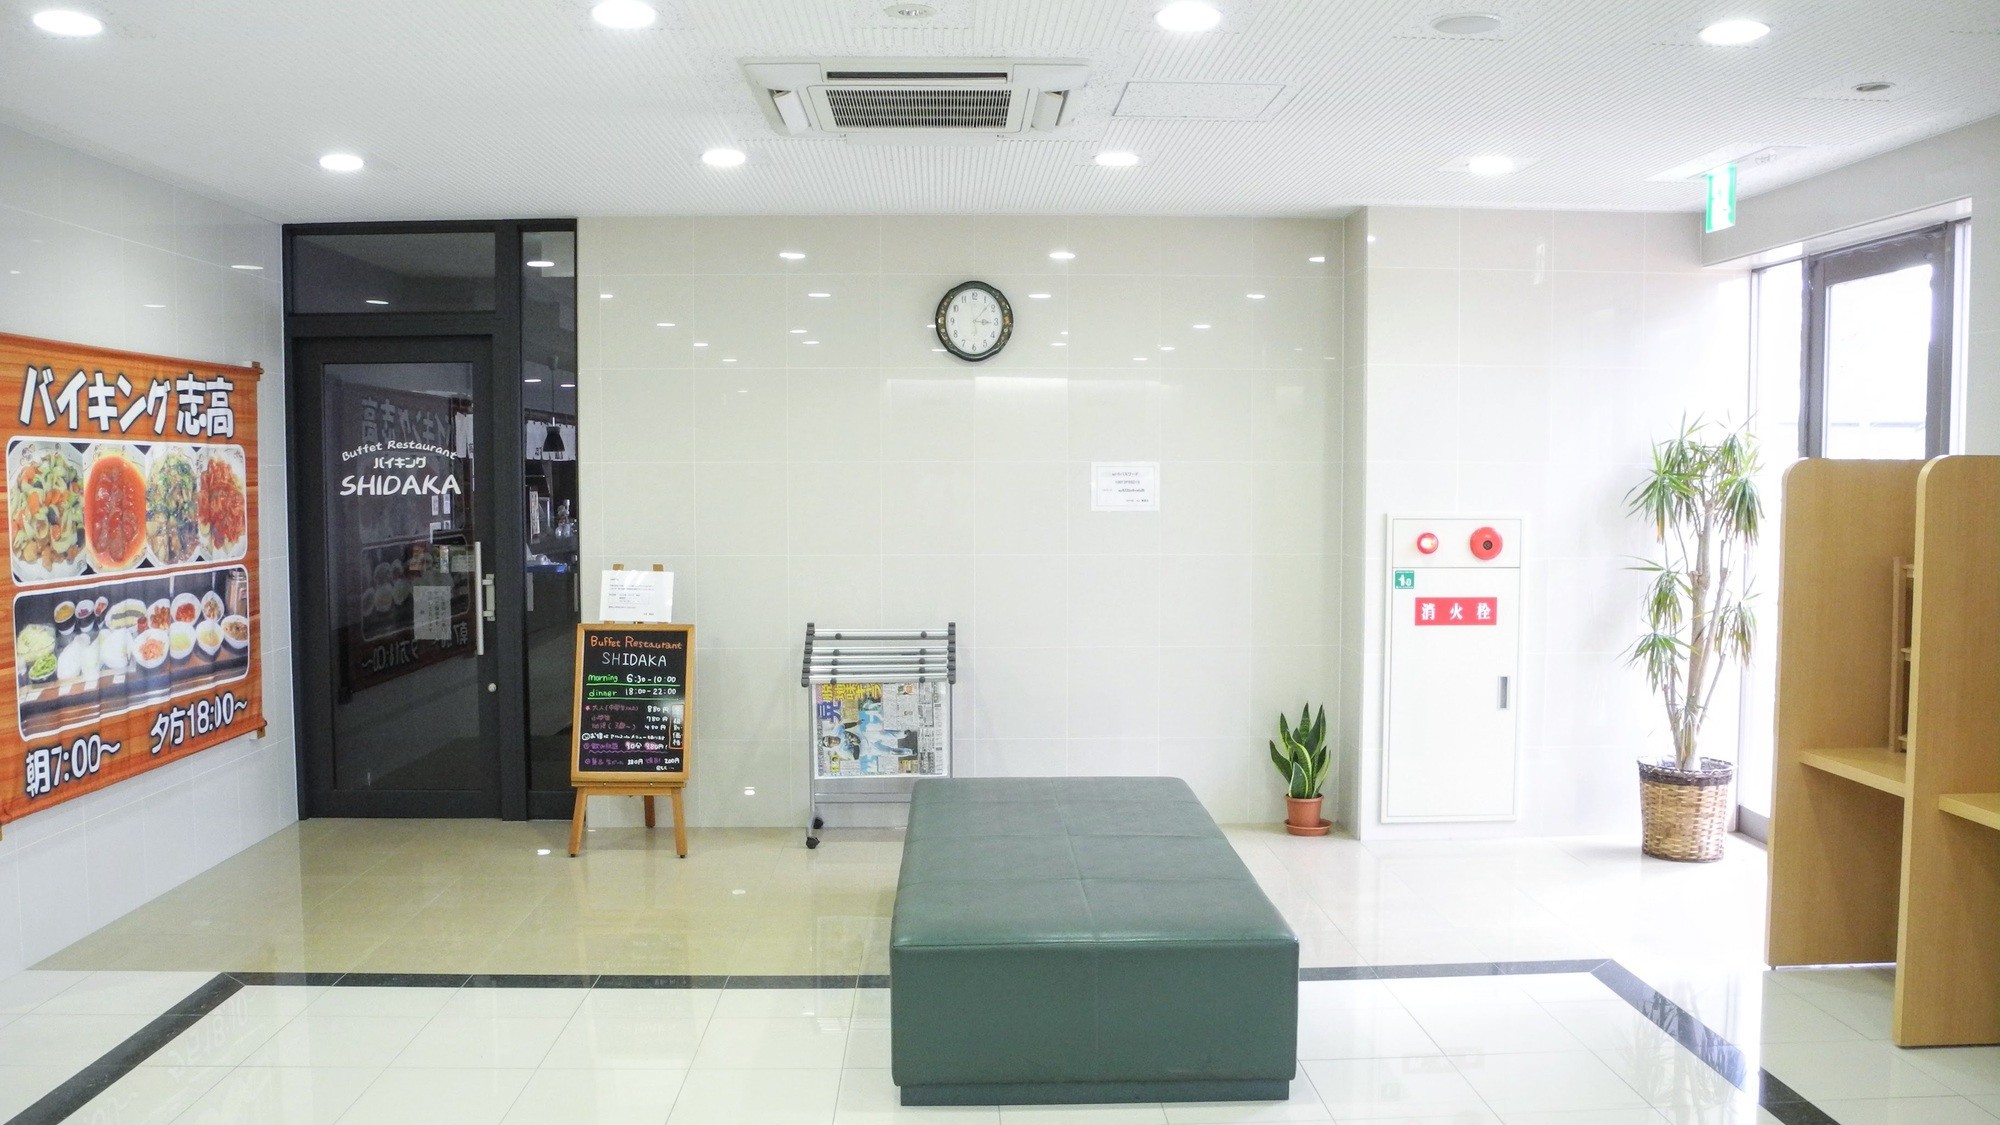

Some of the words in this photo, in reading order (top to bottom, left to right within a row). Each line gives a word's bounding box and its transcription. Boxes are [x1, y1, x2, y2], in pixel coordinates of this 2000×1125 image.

[971, 292, 978, 301] 12
[950, 317, 955, 325] 9
[993, 318, 999, 326] 3
[953, 330, 958, 338] 8
[971, 343, 977, 351] 6
[18, 364, 171, 436] バイキング
[176, 372, 235, 438] 志高
[341, 441, 383, 462] Buffet
[387, 440, 458, 461] Restaurant
[373, 456, 427, 469] バイキング
[339, 474, 462, 496] SHIDAKA
[1421, 602, 1491, 621] 消火栓
[625, 635, 682, 649] Restaurant
[601, 652, 667, 667] SHIDAKA
[589, 689, 618, 697] dinner
